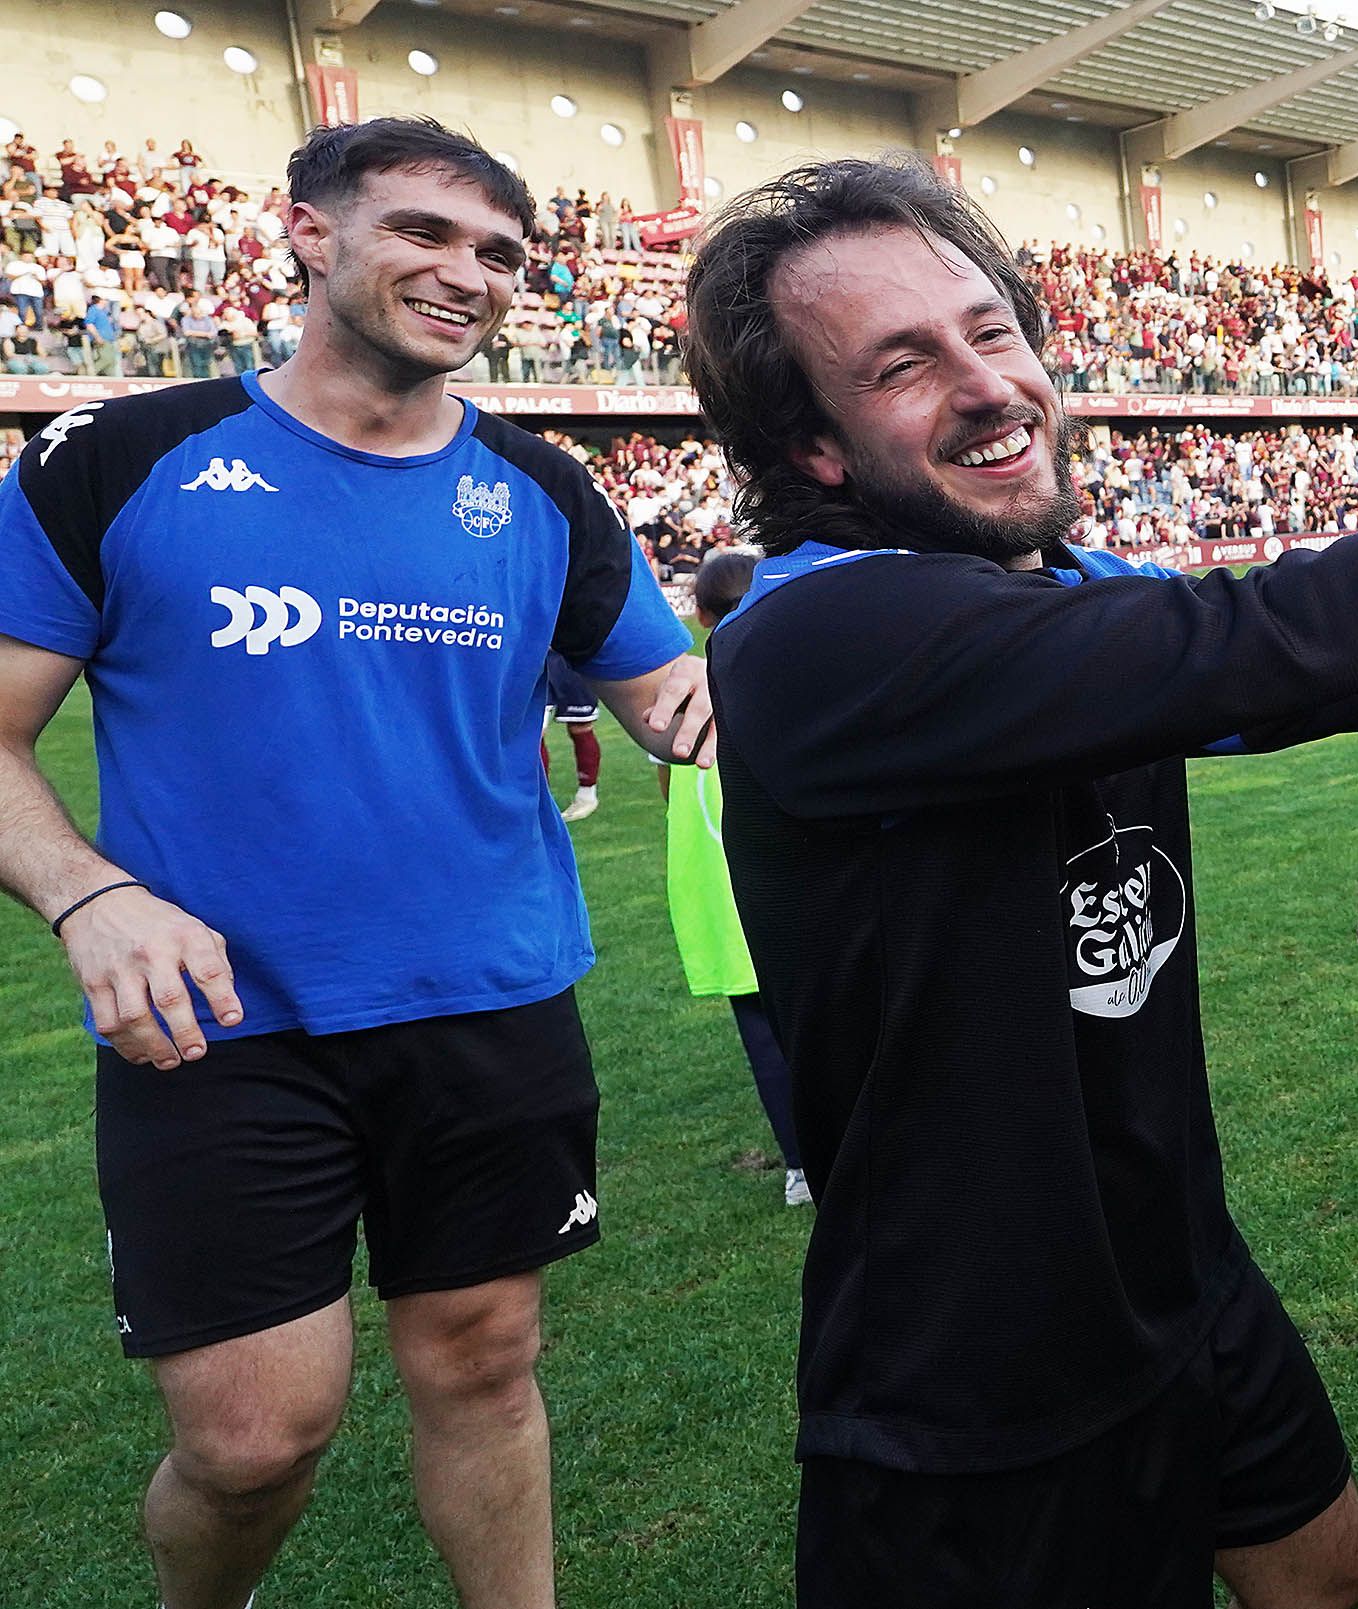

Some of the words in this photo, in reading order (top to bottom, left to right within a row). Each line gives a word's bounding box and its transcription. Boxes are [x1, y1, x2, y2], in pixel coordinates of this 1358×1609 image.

[505, 397, 573, 413] PALACE
[596, 390, 657, 413] Diario
[338, 597, 504, 628] Deputación
[339, 620, 502, 649] Pontevedra
